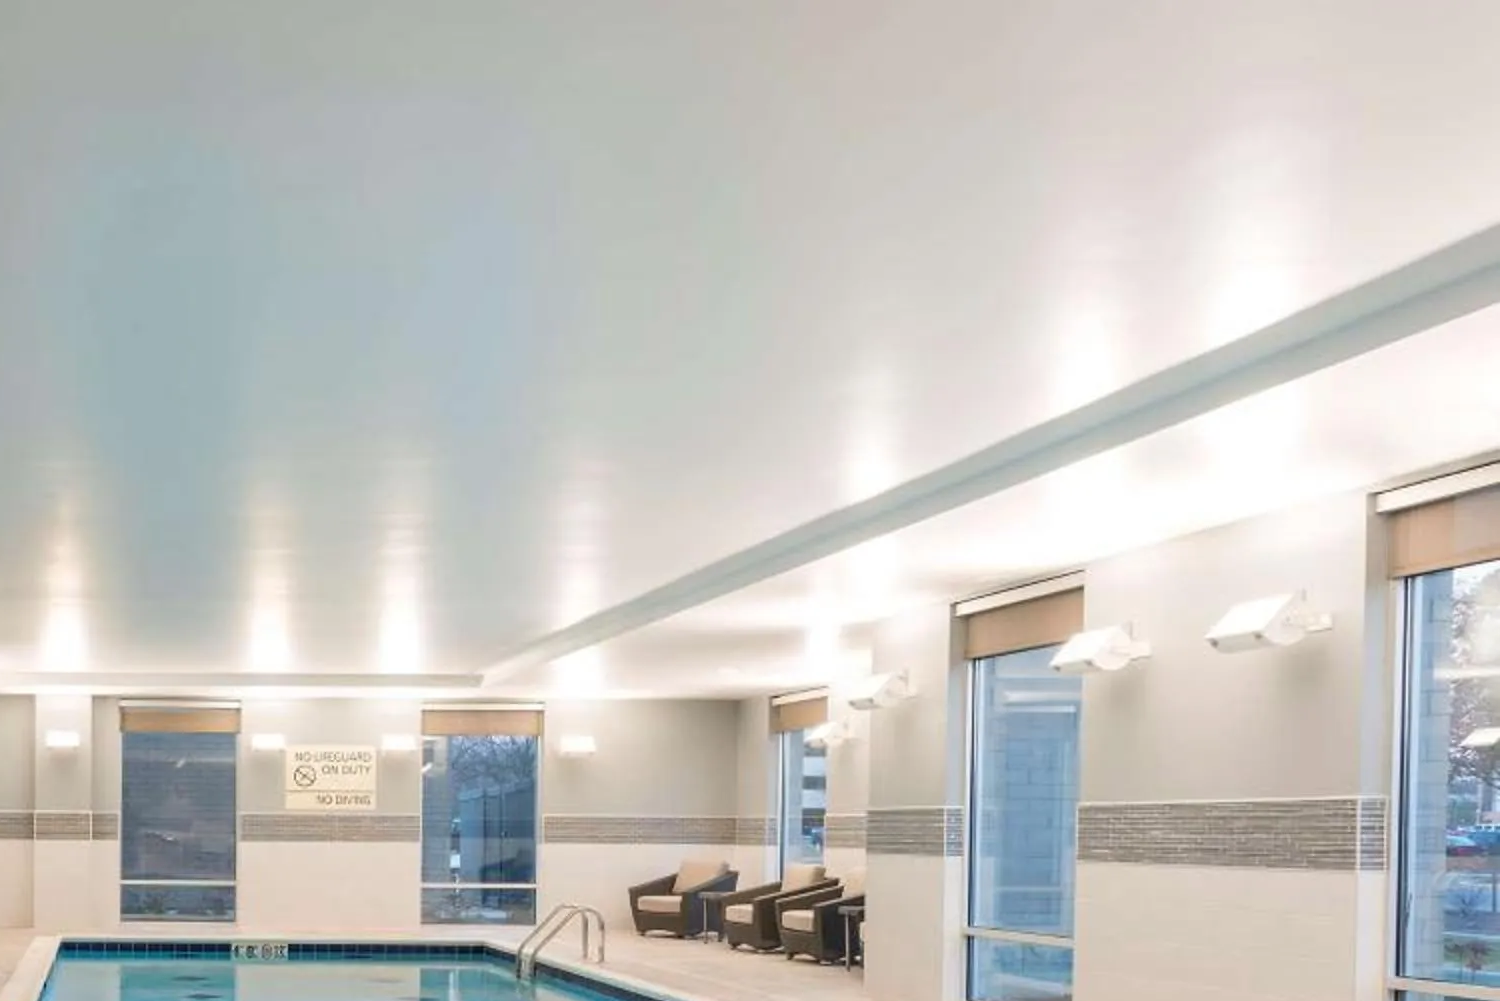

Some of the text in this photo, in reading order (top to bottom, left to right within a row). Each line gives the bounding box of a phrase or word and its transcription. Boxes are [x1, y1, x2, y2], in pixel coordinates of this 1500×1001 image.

[295, 751, 372, 762] NO LIFEGUARD
[321, 764, 371, 775] ON DUTY
[317, 795, 371, 806] NO DIVING
